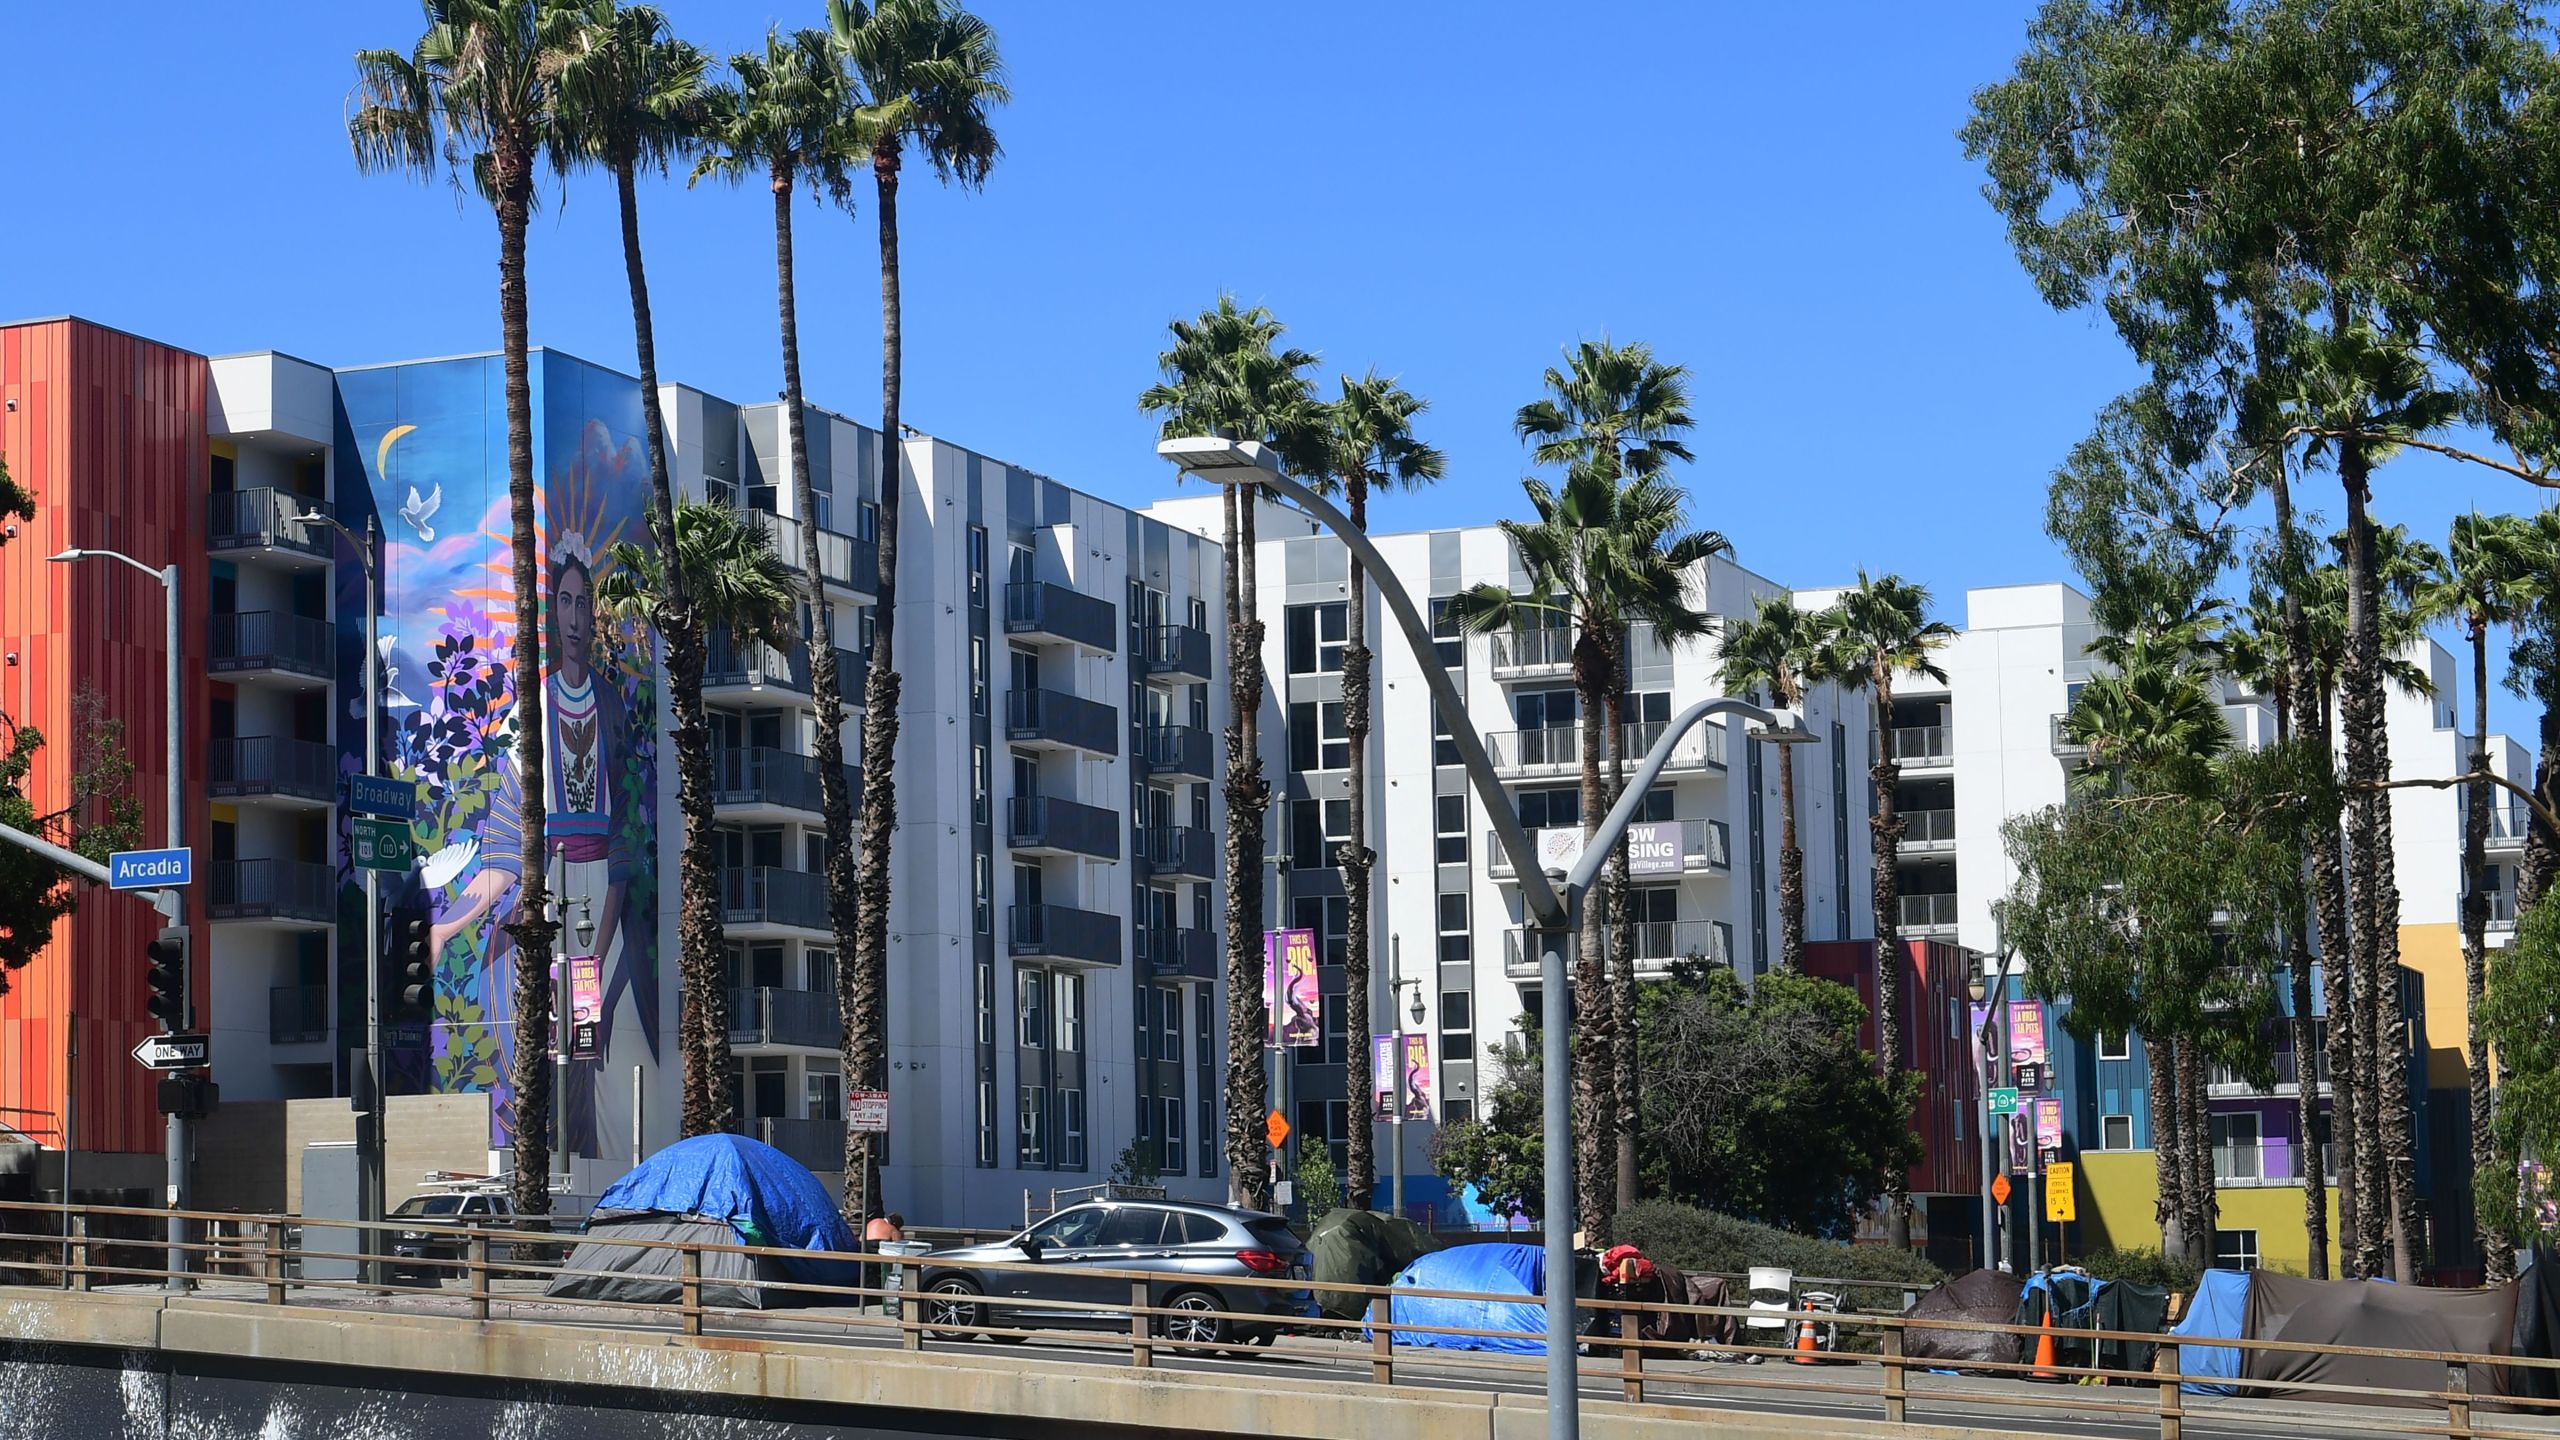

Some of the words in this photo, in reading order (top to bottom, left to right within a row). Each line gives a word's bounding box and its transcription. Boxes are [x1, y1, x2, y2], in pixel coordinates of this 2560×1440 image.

[356, 782, 412, 812] Broadway
[355, 824, 376, 837] NORTH
[1627, 827, 1656, 843] OW
[383, 843, 393, 854] 110
[1628, 842, 1674, 858] SING
[119, 858, 182, 879] Arcadia
[1288, 934, 1301, 945] THIS
[1302, 934, 1308, 944] IS
[2014, 1011, 2021, 1022] LA
[155, 1046, 176, 1058] ONE
[180, 1045, 200, 1057] WAY
[850, 1100, 860, 1110] NO
[862, 1101, 887, 1109] STOPPING
[854, 1111, 866, 1119] ANY
